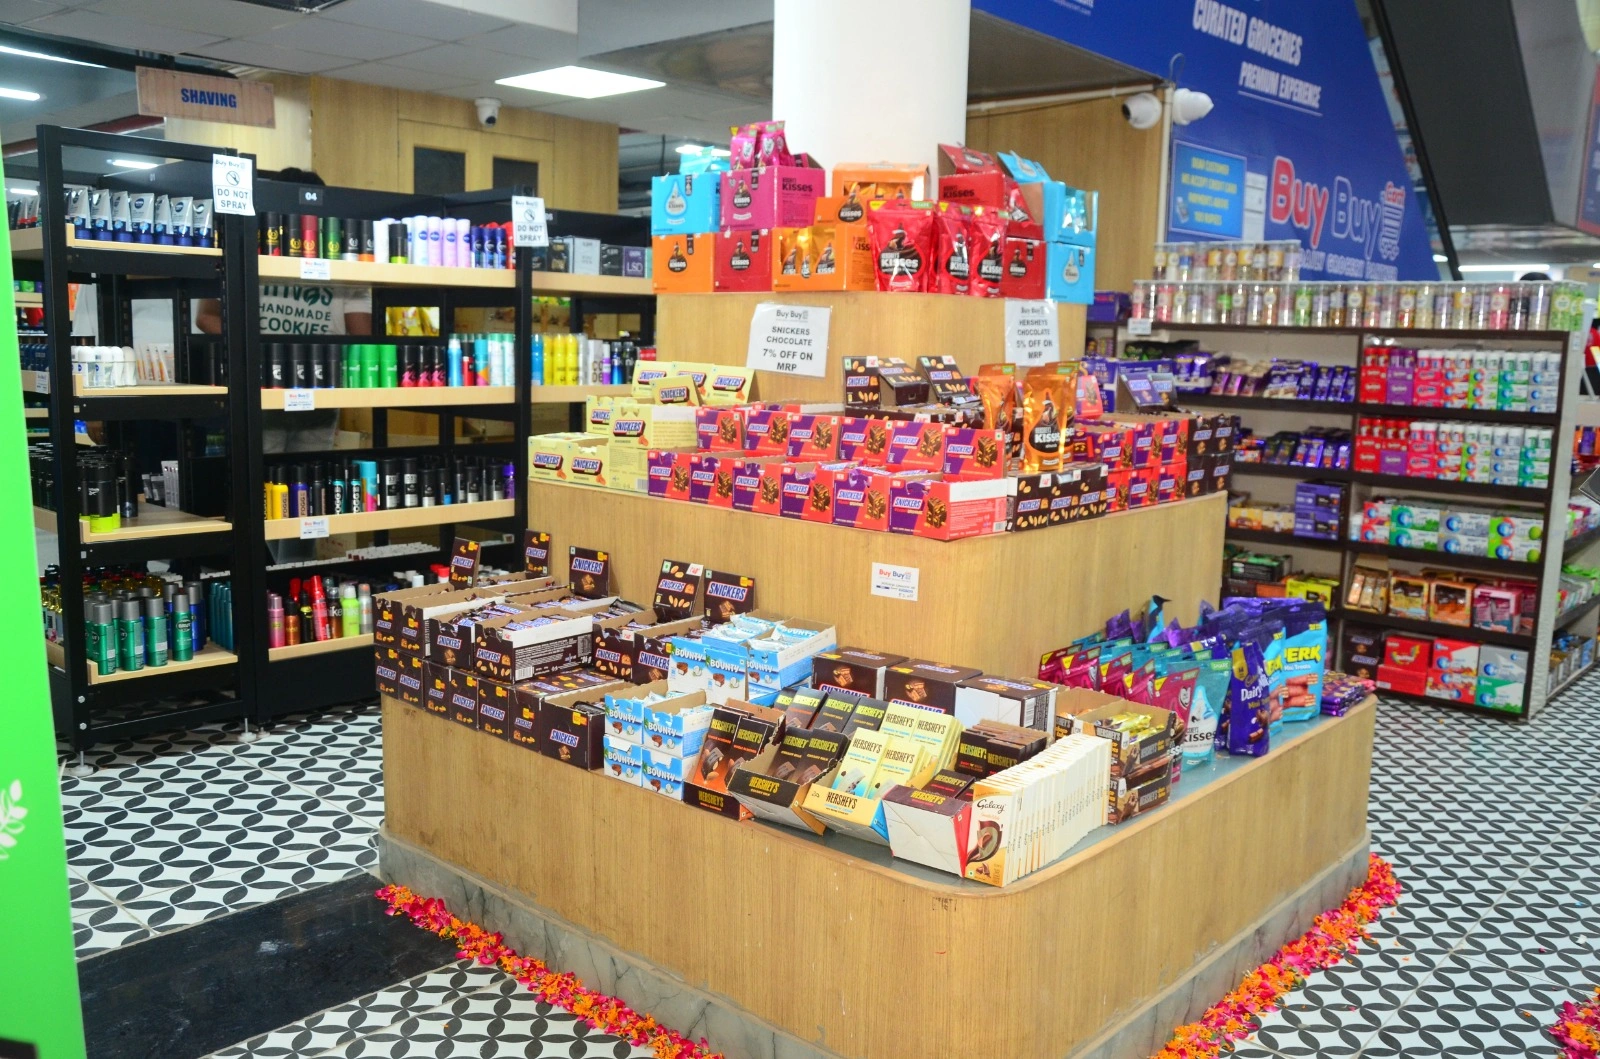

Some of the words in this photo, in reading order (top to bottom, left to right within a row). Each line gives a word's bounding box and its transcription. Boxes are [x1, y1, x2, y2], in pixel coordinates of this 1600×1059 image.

[1193, 0, 1247, 46] CURATED
[1247, 16, 1302, 66] GROCERIES
[1239, 61, 1280, 96] PREMIUM
[1279, 74, 1322, 109] EXPERIENCE
[181, 88, 237, 108] SHAVING
[782, 181, 812, 192] Kisses
[218, 188, 230, 196] DO
[233, 190, 248, 199] NOT
[306, 192, 318, 201] 04
[943, 189, 974, 199] Kisses
[220, 200, 246, 210] SPRAY
[1270, 156, 1329, 249] Buy
[1332, 176, 1381, 260] Buy
[627, 262, 643, 272] LSD
[881, 258, 918, 269] Kisses
[950, 261, 968, 270] Kiss
[259, 303, 331, 321] HANDMADE
[776, 310, 789, 318] Buy
[790, 310, 802, 320] Buy
[259, 316, 329, 334] COOKIES
[772, 326, 810, 336] SNICKERS
[766, 336, 812, 346] CHOCOLATE
[1028, 340, 1041, 348] OFF
[762, 348, 776, 358] 7%
[780, 350, 798, 359] OFF
[800, 352, 813, 360] ON
[776, 362, 798, 372] MRP
[714, 375, 744, 388] SNICKERS
[848, 376, 869, 386] SNICKERS
[930, 372, 952, 380] SNICKERS
[660, 386, 687, 399] SNICKERS
[592, 410, 610, 420] SNICKE
[614, 421, 642, 432] SNICKERS
[843, 434, 865, 442] SNICKERS
[894, 436, 919, 444] SNICKERS
[948, 446, 974, 454] SNICKERS
[534, 454, 561, 466] SNICKERS
[572, 458, 600, 471] SNICKERS
[650, 468, 671, 476] SNICKERS
[692, 472, 714, 481] SNICKERS
[736, 477, 758, 486] SNICKERS
[784, 484, 808, 494] SNICKERS
[838, 490, 863, 500] SNICKERS
[894, 498, 922, 508] SNICKERS
[526, 548, 546, 558] SNICKERS
[452, 557, 473, 568] SNICKERS
[574, 558, 603, 573] SNICKERS
[879, 568, 891, 578] Buy
[892, 570, 905, 580] Buy
[660, 580, 684, 591] SNICKERS
[709, 584, 746, 599] SNICKERS
[438, 636, 462, 648] SNICKERS
[478, 650, 500, 662] SNICKERS
[596, 650, 620, 662] SNICKERS
[675, 648, 702, 660] BOUNTY
[710, 659, 740, 672] BOUNTY
[377, 667, 396, 680] SNICKERS
[400, 674, 420, 689] SNICKERS
[429, 689, 444, 698] SNICKERS
[1241, 688, 1262, 702] Dairy
[454, 694, 475, 709] SNICKERS
[482, 705, 504, 720] SNICKERS
[609, 709, 636, 722] BOUNTY
[516, 718, 532, 729] SNICKERS
[711, 718, 736, 734] HERSHEY'S
[886, 713, 914, 728] HERSHEY'S
[648, 722, 678, 736] BOUNTY
[918, 720, 946, 734] HERSHEY'S
[552, 730, 578, 746] SNICKERS
[737, 728, 763, 744] HERSHEY'S
[784, 736, 809, 749] HERSHEY
[809, 738, 838, 753] HERSHEY'S
[852, 738, 882, 754] HERSHEY'S
[608, 752, 636, 766] BOUNTY
[885, 749, 916, 764] HERSHEY'S
[646, 766, 676, 780] BOUNTY
[749, 776, 780, 794] HERSHEY'S
[934, 774, 967, 787] HERSHEY'S
[698, 790, 724, 808] HERSHEY'S
[826, 792, 858, 810] HERSHEY'S
[910, 790, 946, 805] HERSHEY'S
[976, 798, 1005, 814] Galaxy
